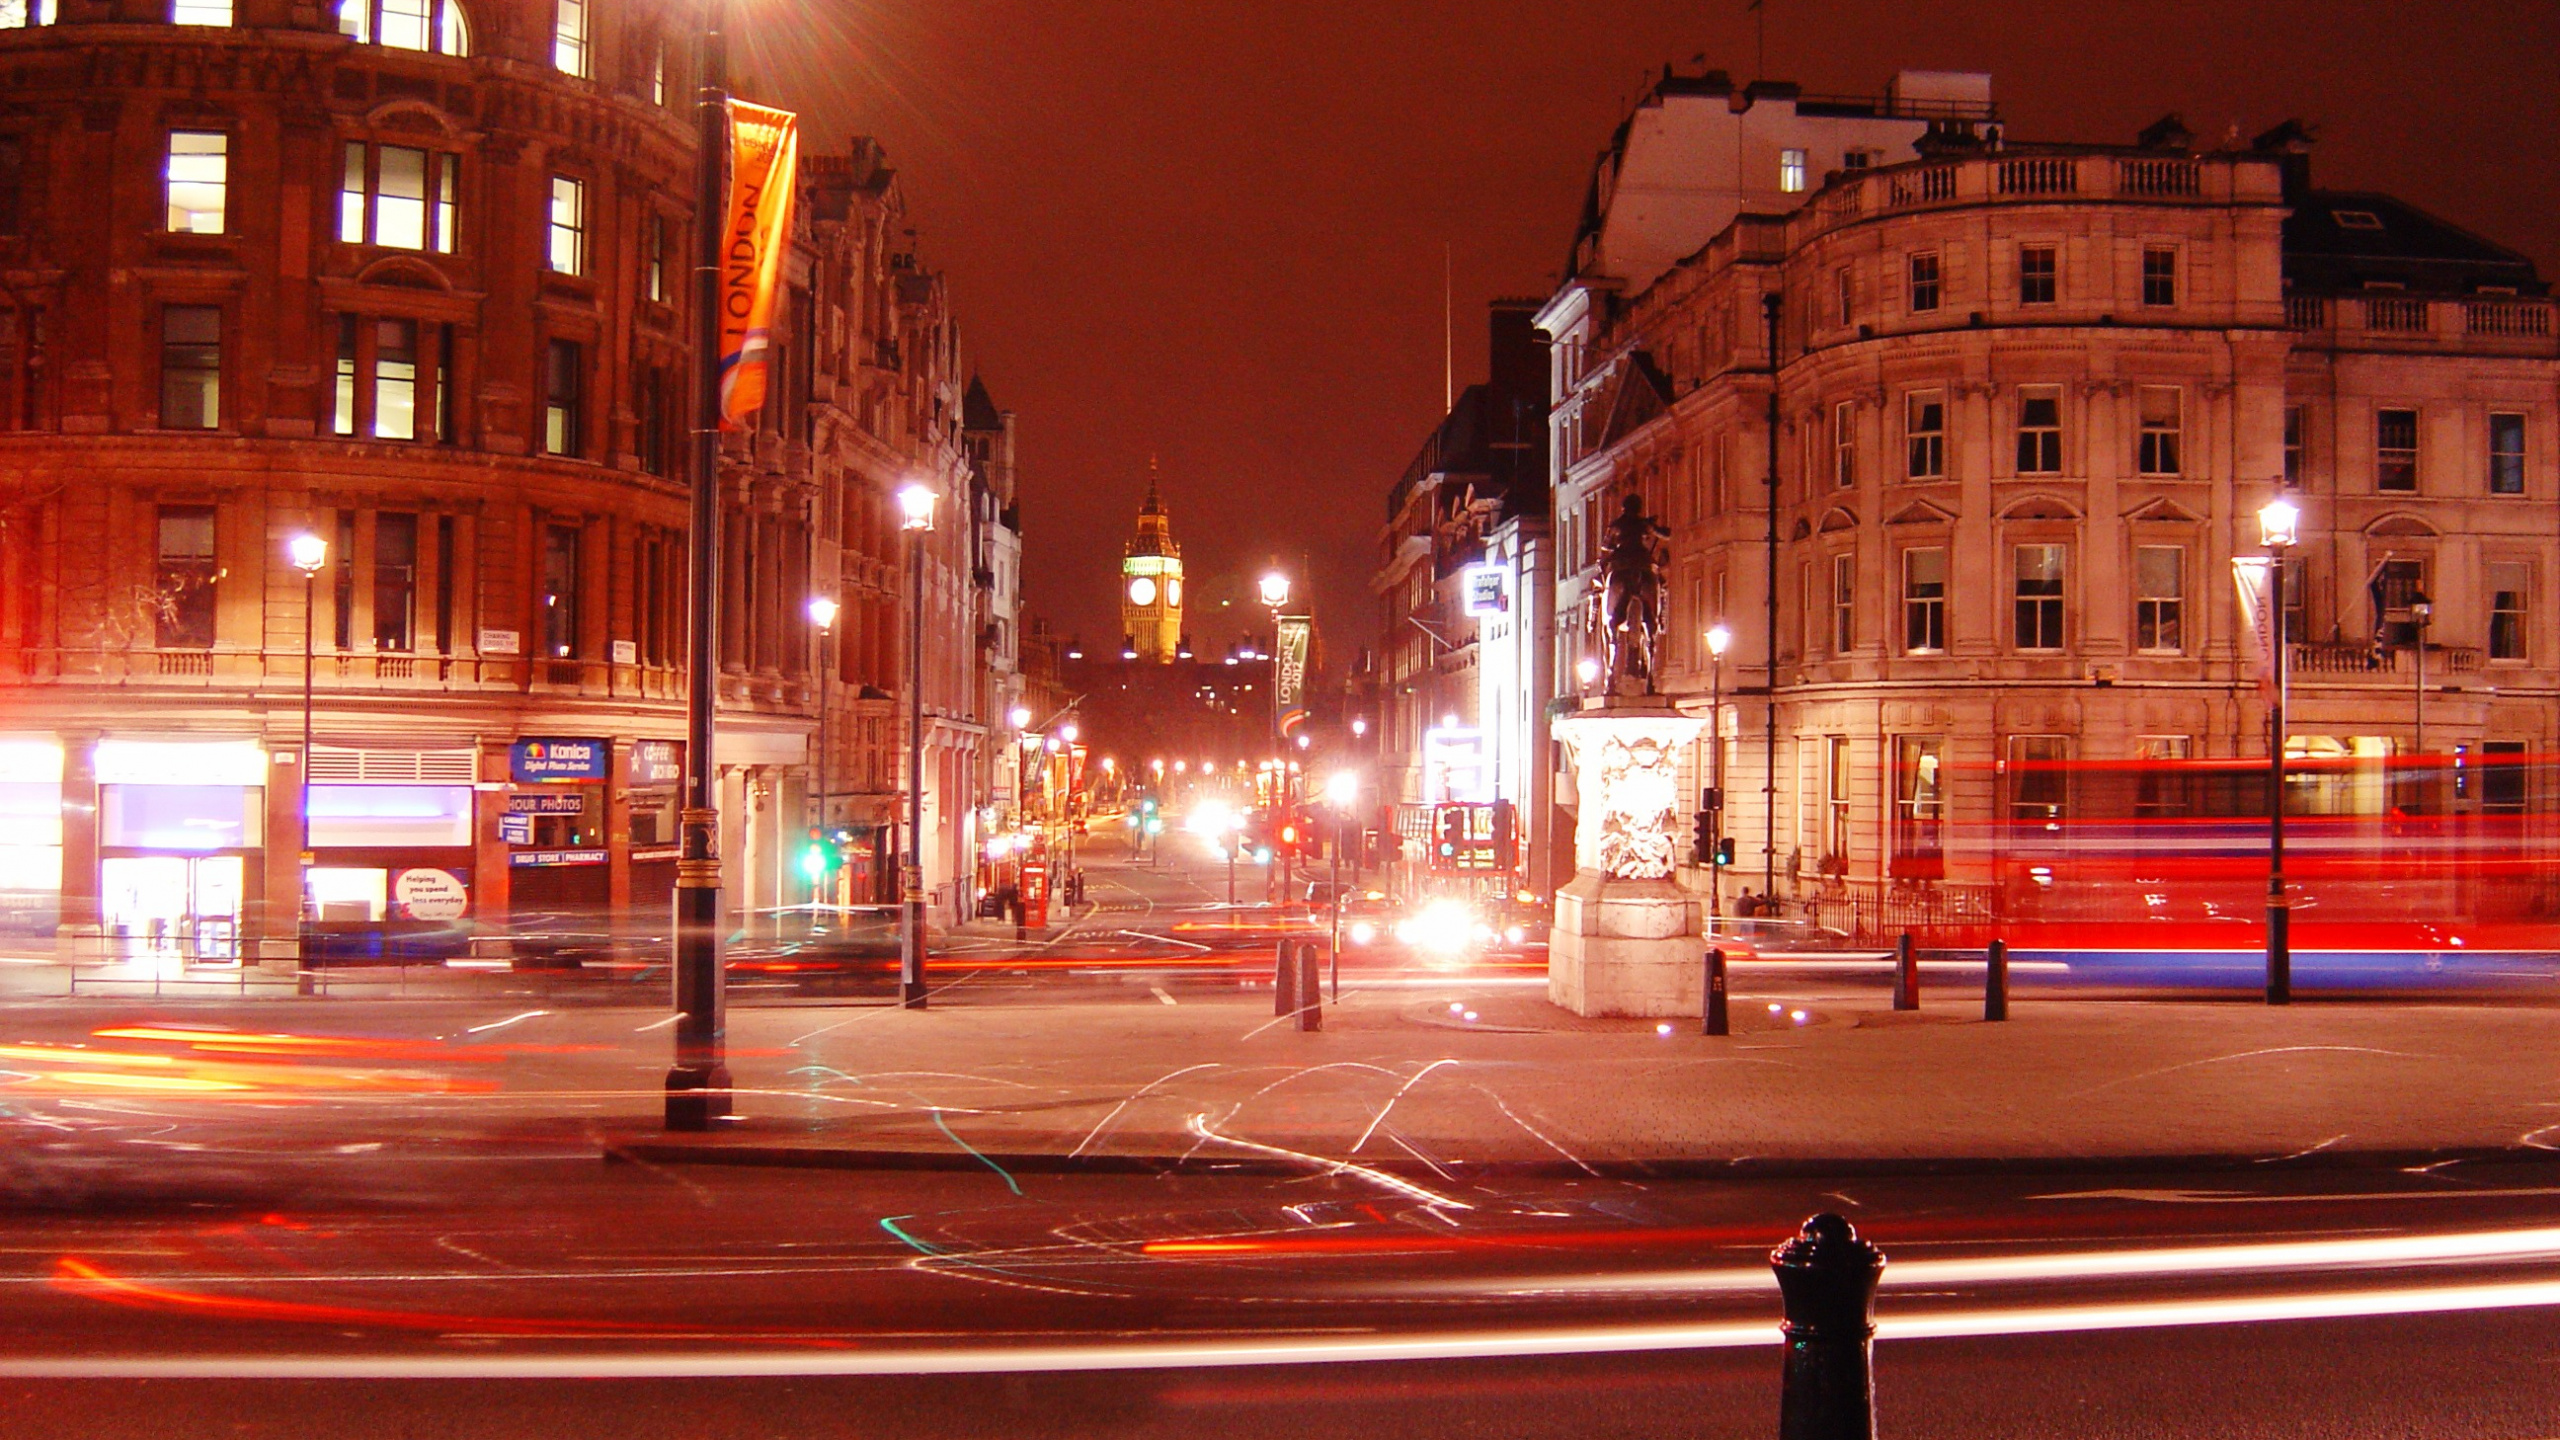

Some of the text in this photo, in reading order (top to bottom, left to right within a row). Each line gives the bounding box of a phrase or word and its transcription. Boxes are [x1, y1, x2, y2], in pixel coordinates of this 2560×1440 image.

[1280, 646, 1295, 704] LONDON
[1290, 661, 1303, 689] 2012
[550, 744, 591, 759] Konica
[667, 764, 680, 779] GO
[509, 799, 581, 811] HOUR PHOTOS
[538, 854, 560, 863] STORE
[565, 852, 604, 862] PHARMACY
[406, 876, 436, 884] Helping
[428, 896, 464, 904] everyday
